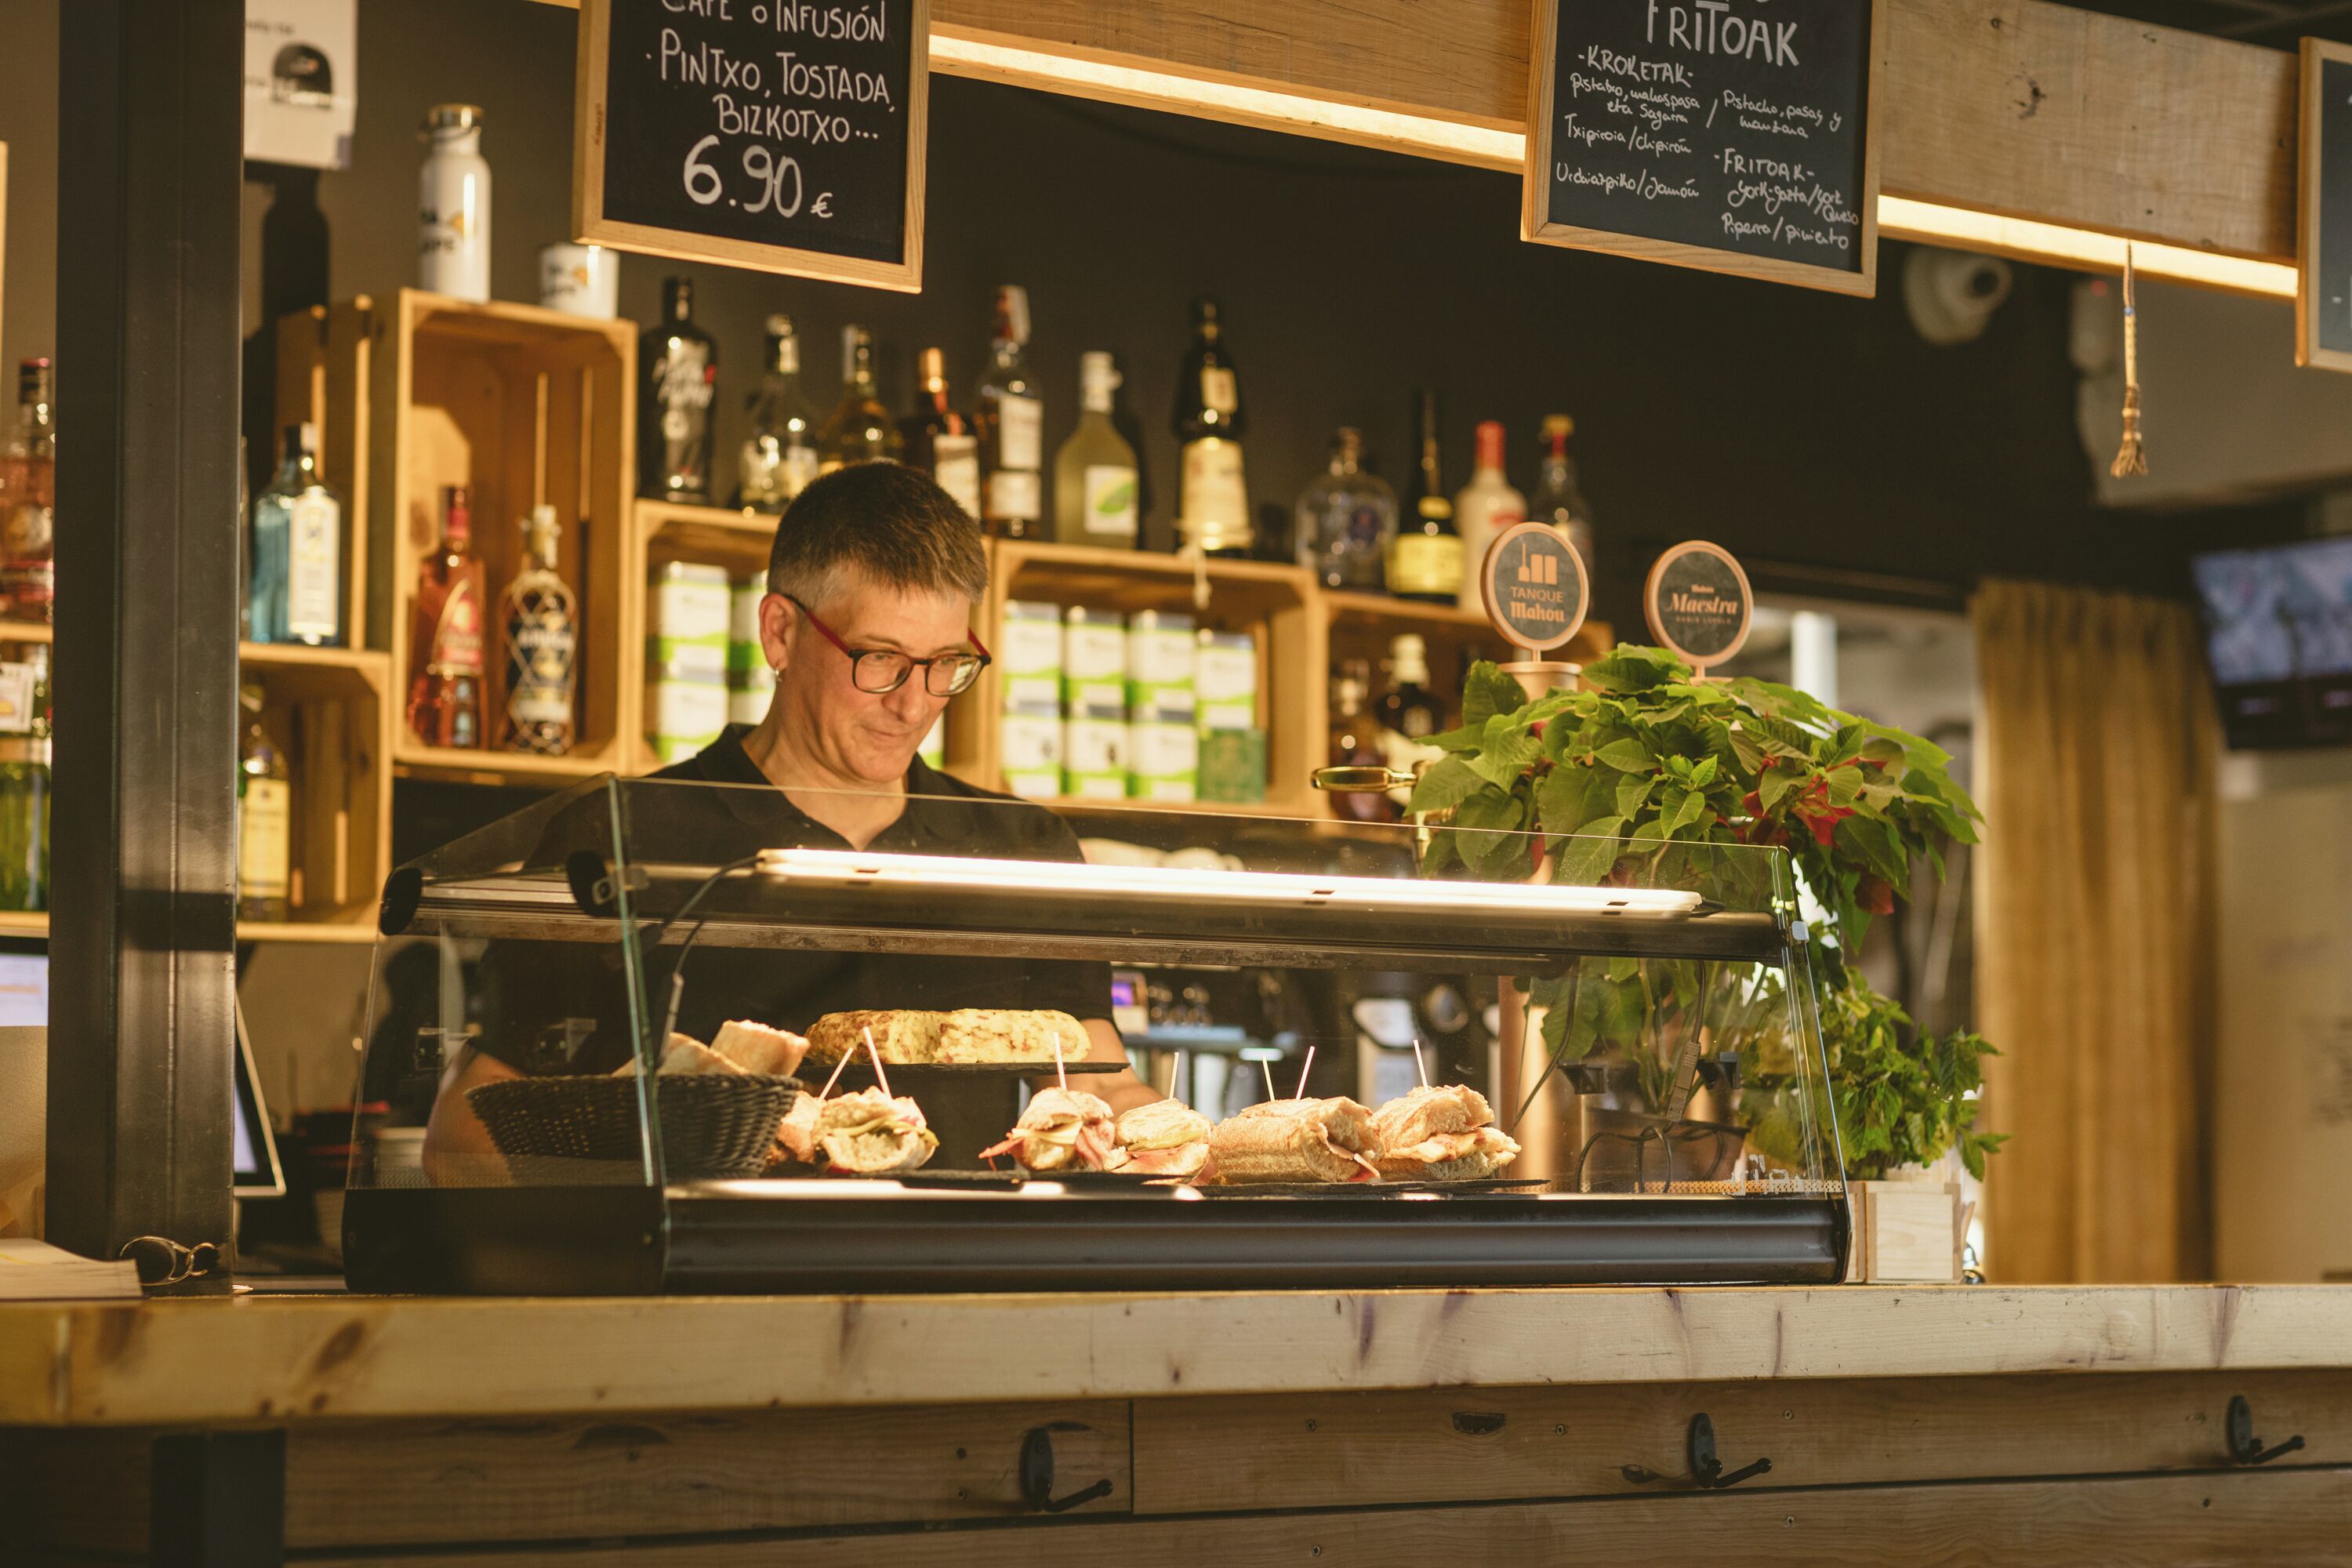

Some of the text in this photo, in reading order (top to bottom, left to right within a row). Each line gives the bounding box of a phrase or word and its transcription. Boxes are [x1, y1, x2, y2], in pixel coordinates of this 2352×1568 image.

[1646, 0, 1800, 67] FRITOAK
[1510, 586, 1564, 603] TANQUE
[1664, 593, 1738, 615] Maestra
[1510, 601, 1565, 622] Mahou
